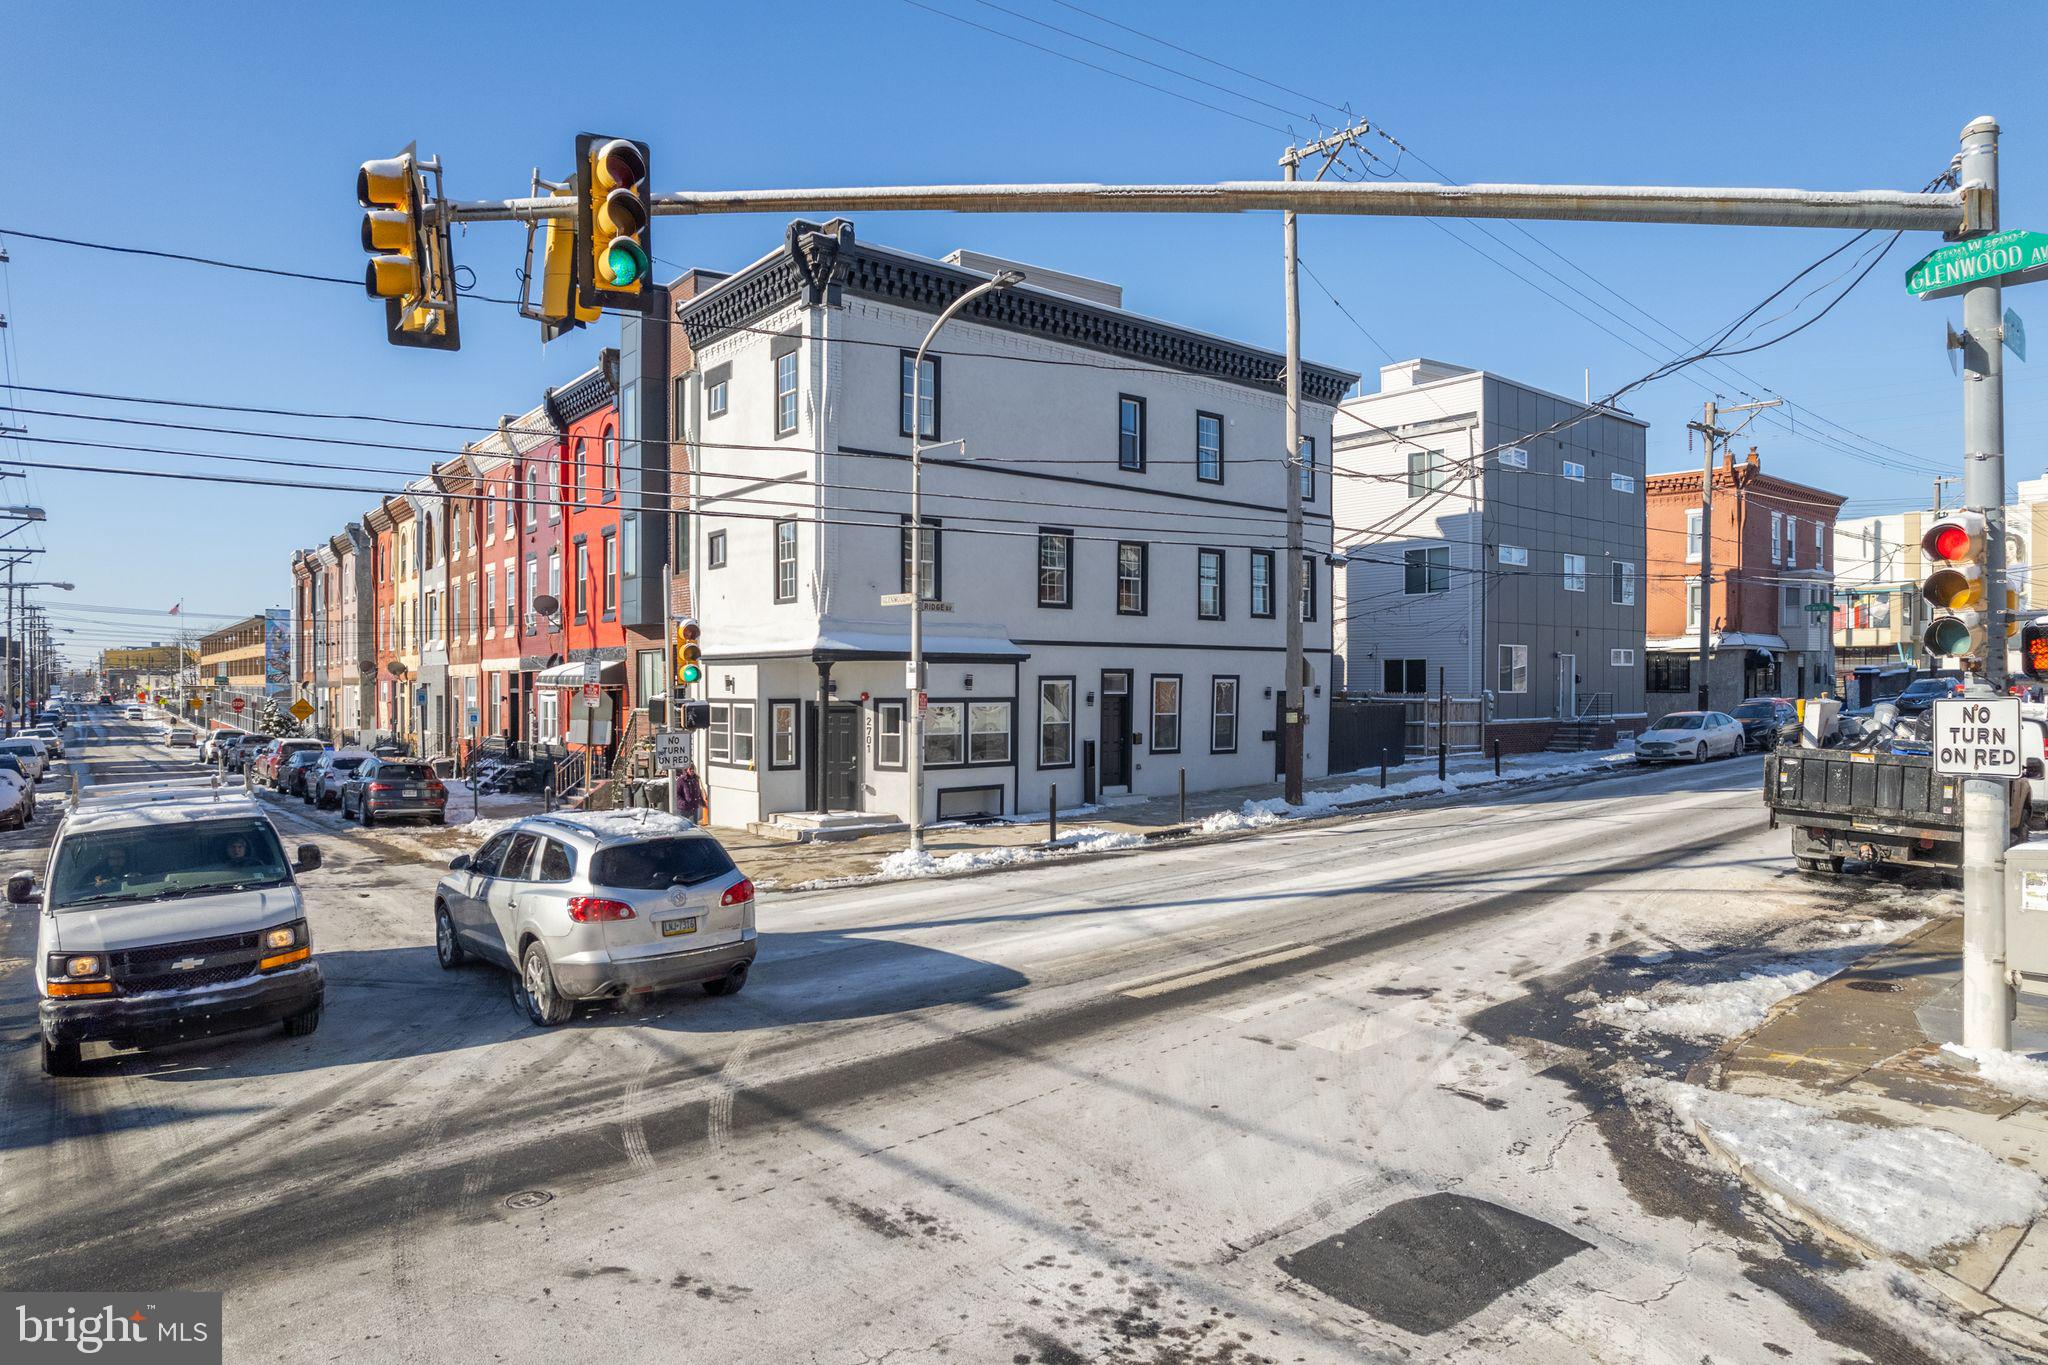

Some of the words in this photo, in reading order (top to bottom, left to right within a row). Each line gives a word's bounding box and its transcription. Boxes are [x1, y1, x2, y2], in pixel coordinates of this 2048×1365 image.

[1968, 239, 1983, 255] W
[1911, 245, 2023, 290] GLENWOOD
[924, 602, 945, 612] RIDGE
[1962, 706, 1991, 724] NO
[668, 735, 680, 745] NO
[1949, 727, 2006, 745] TURN
[662, 746, 686, 755] TURN
[1940, 748, 1967, 764] ON
[1974, 748, 2016, 766] RED
[658, 756, 670, 765] ON
[672, 755, 689, 764] RED
